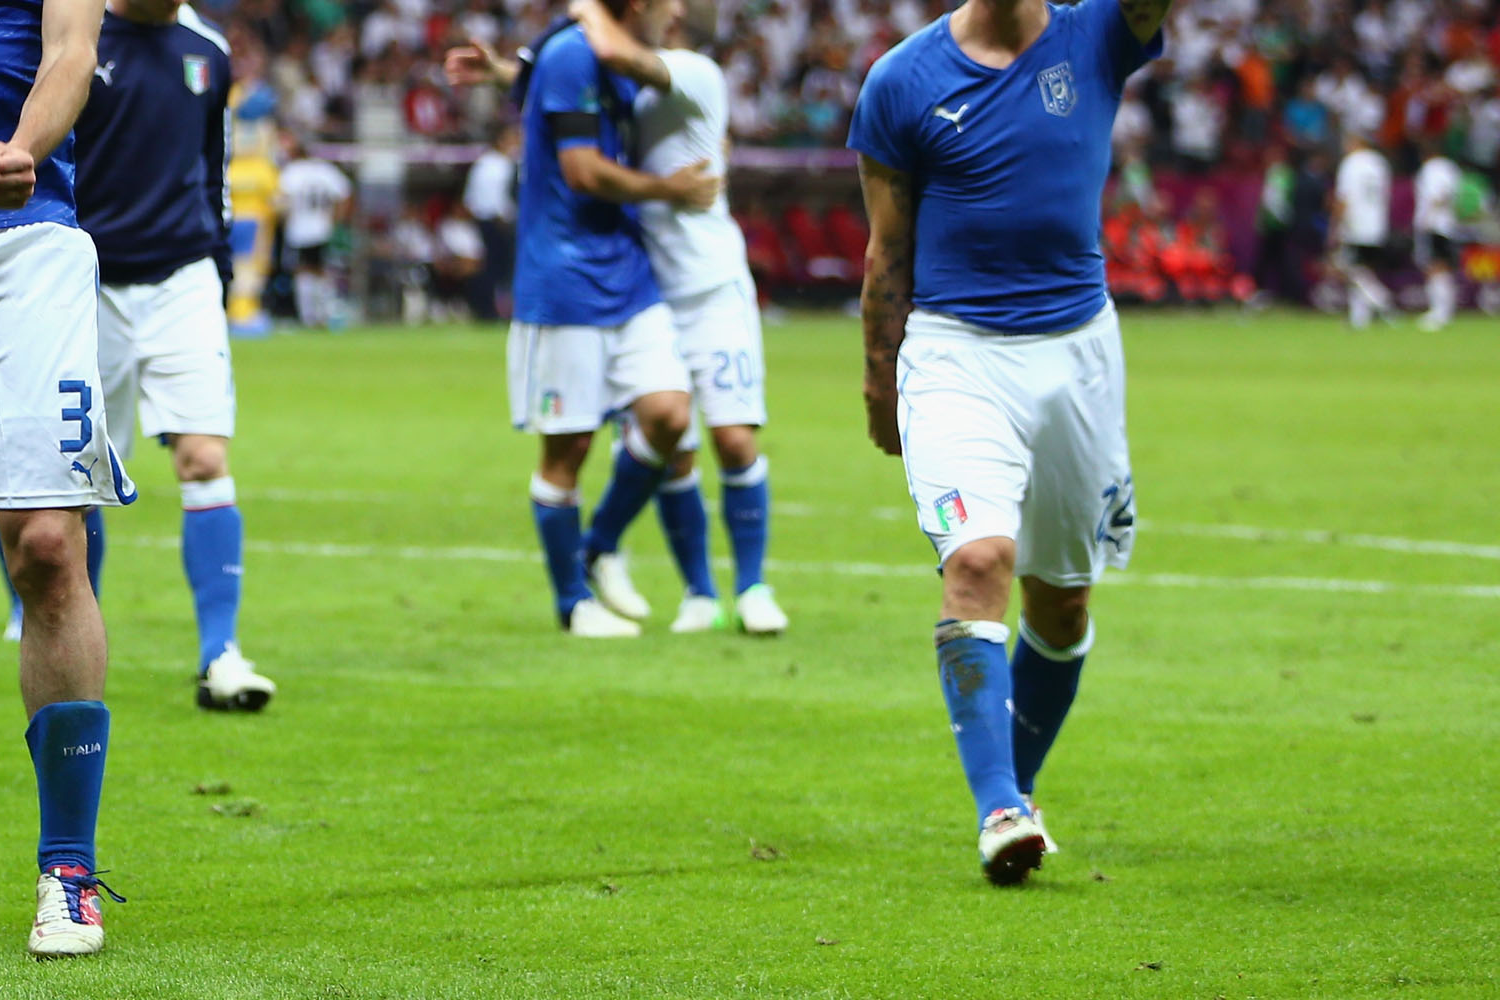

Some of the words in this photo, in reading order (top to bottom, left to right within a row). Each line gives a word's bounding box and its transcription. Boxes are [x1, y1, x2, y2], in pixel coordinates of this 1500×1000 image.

[711, 350, 754, 390] 20
[58, 380, 93, 453] 3
[63, 741, 102, 757] ITALIA
